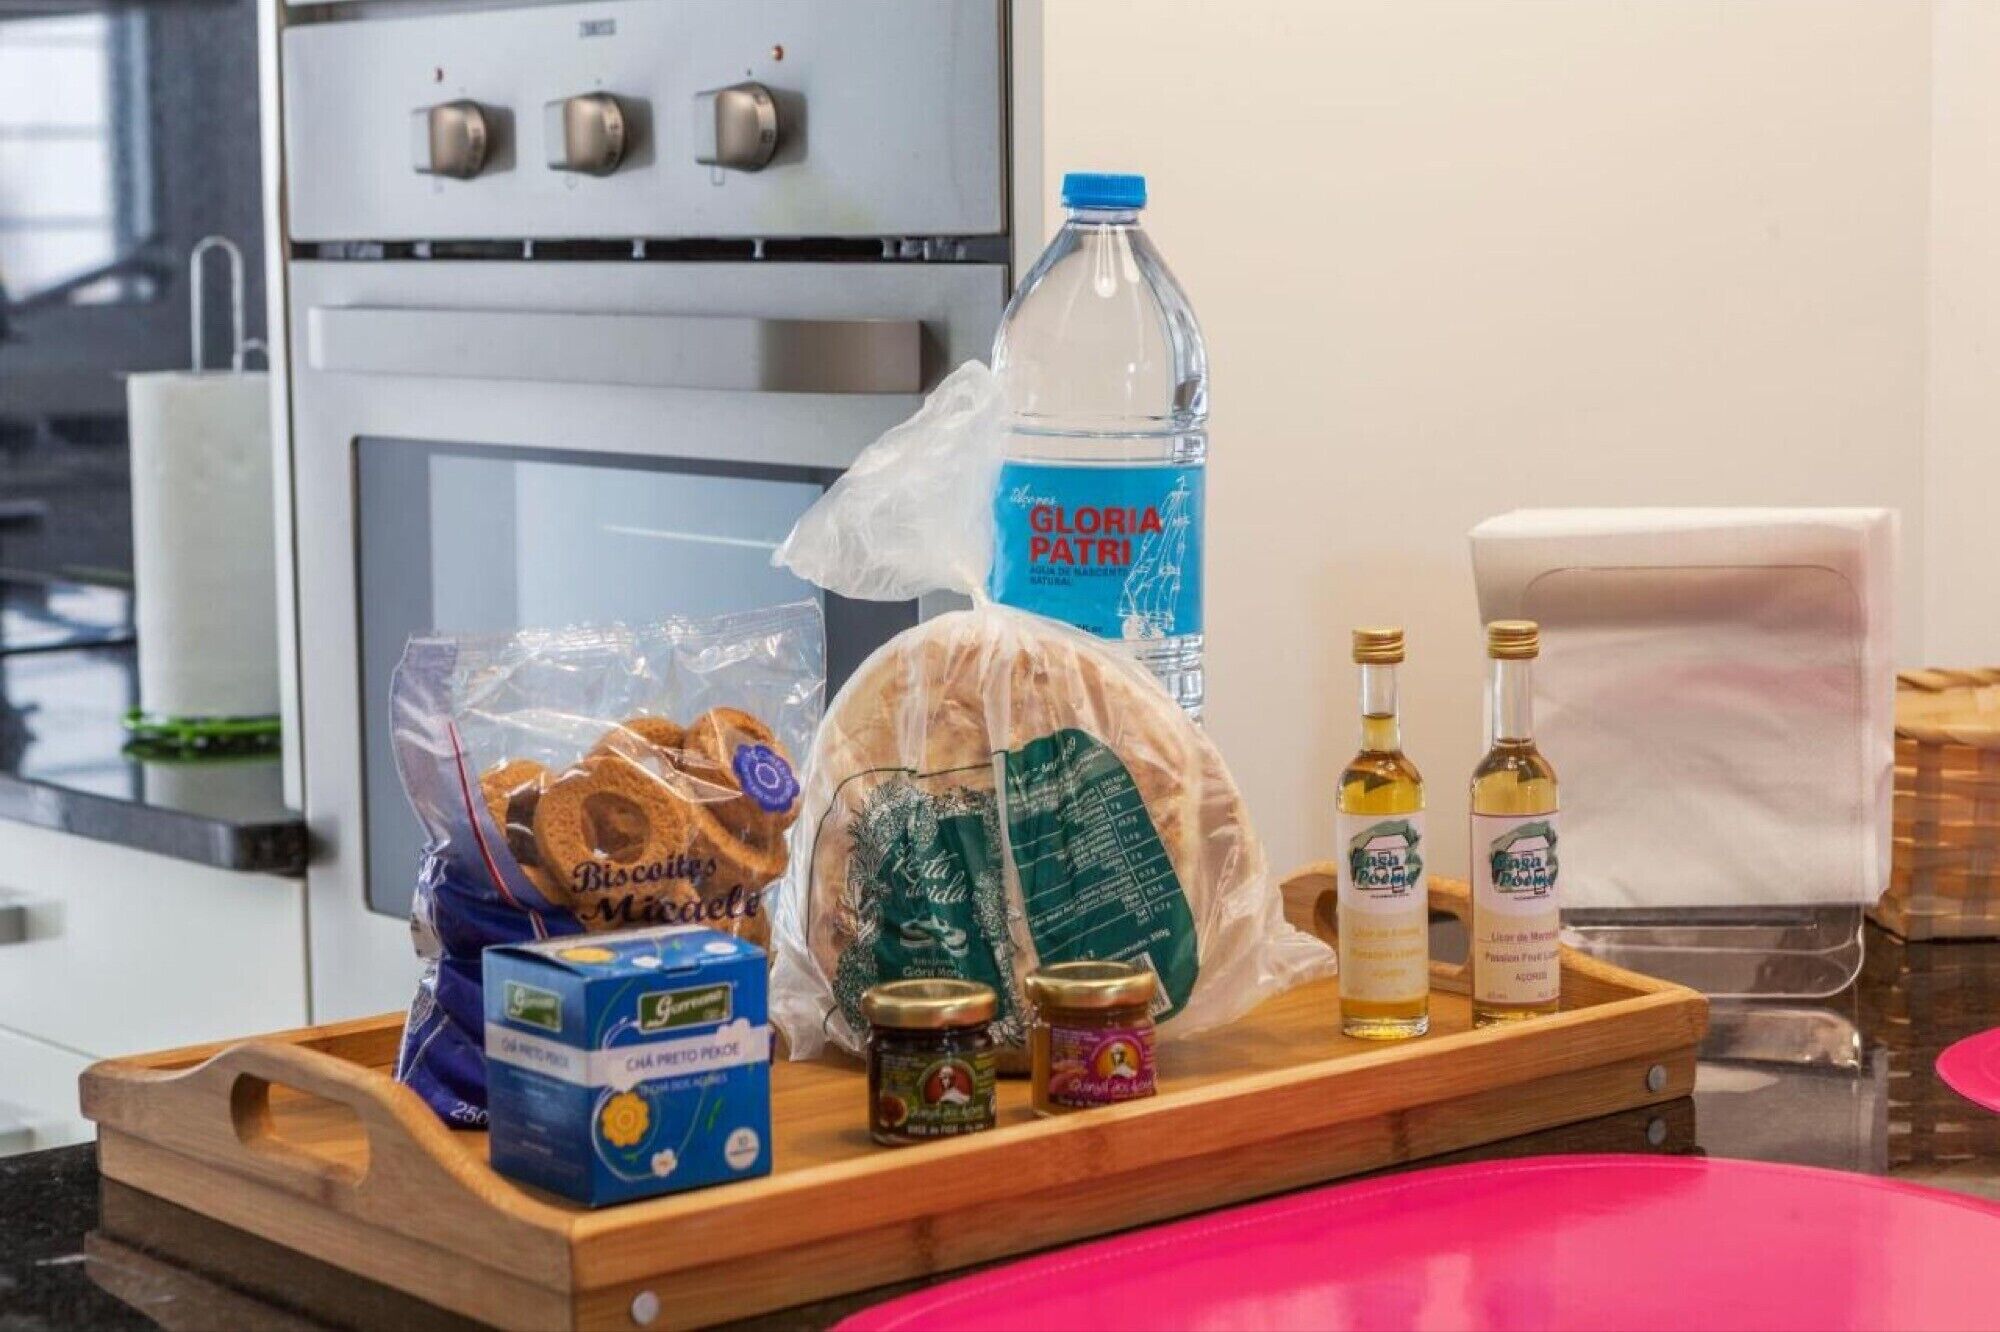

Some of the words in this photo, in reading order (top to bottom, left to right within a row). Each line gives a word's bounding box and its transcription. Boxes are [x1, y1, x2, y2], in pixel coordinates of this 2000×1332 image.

[1029, 505, 1162, 534] GLORIA
[1029, 535, 1132, 565] PATRI
[626, 1054, 653, 1072] CHÁ
[656, 1047, 698, 1067] PRETO
[701, 1042, 740, 1061] PEKOE
[449, 1100, 489, 1124] 250
